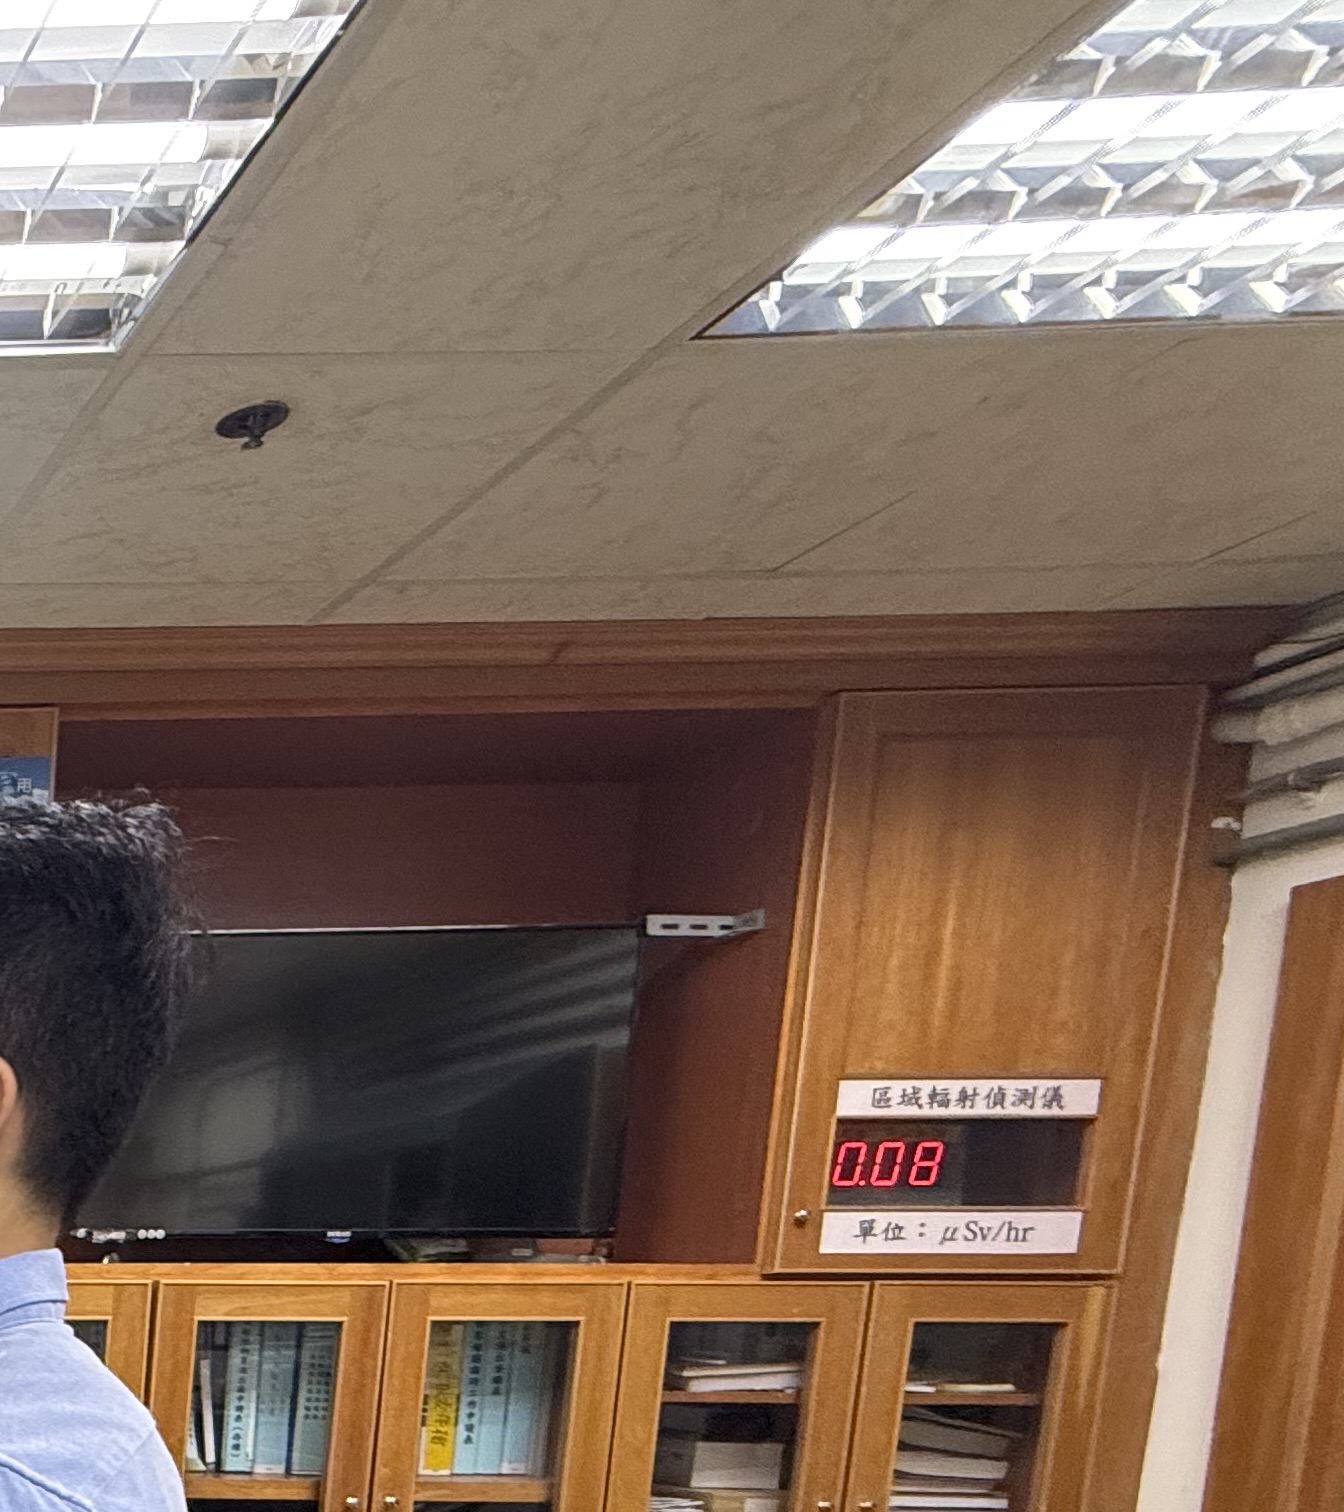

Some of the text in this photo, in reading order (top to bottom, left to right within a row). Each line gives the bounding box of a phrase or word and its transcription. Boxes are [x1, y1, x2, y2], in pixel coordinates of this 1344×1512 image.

[870, 1085, 1065, 1110] 區域輻射偵測儀
[831, 1140, 945, 1187] 0.08
